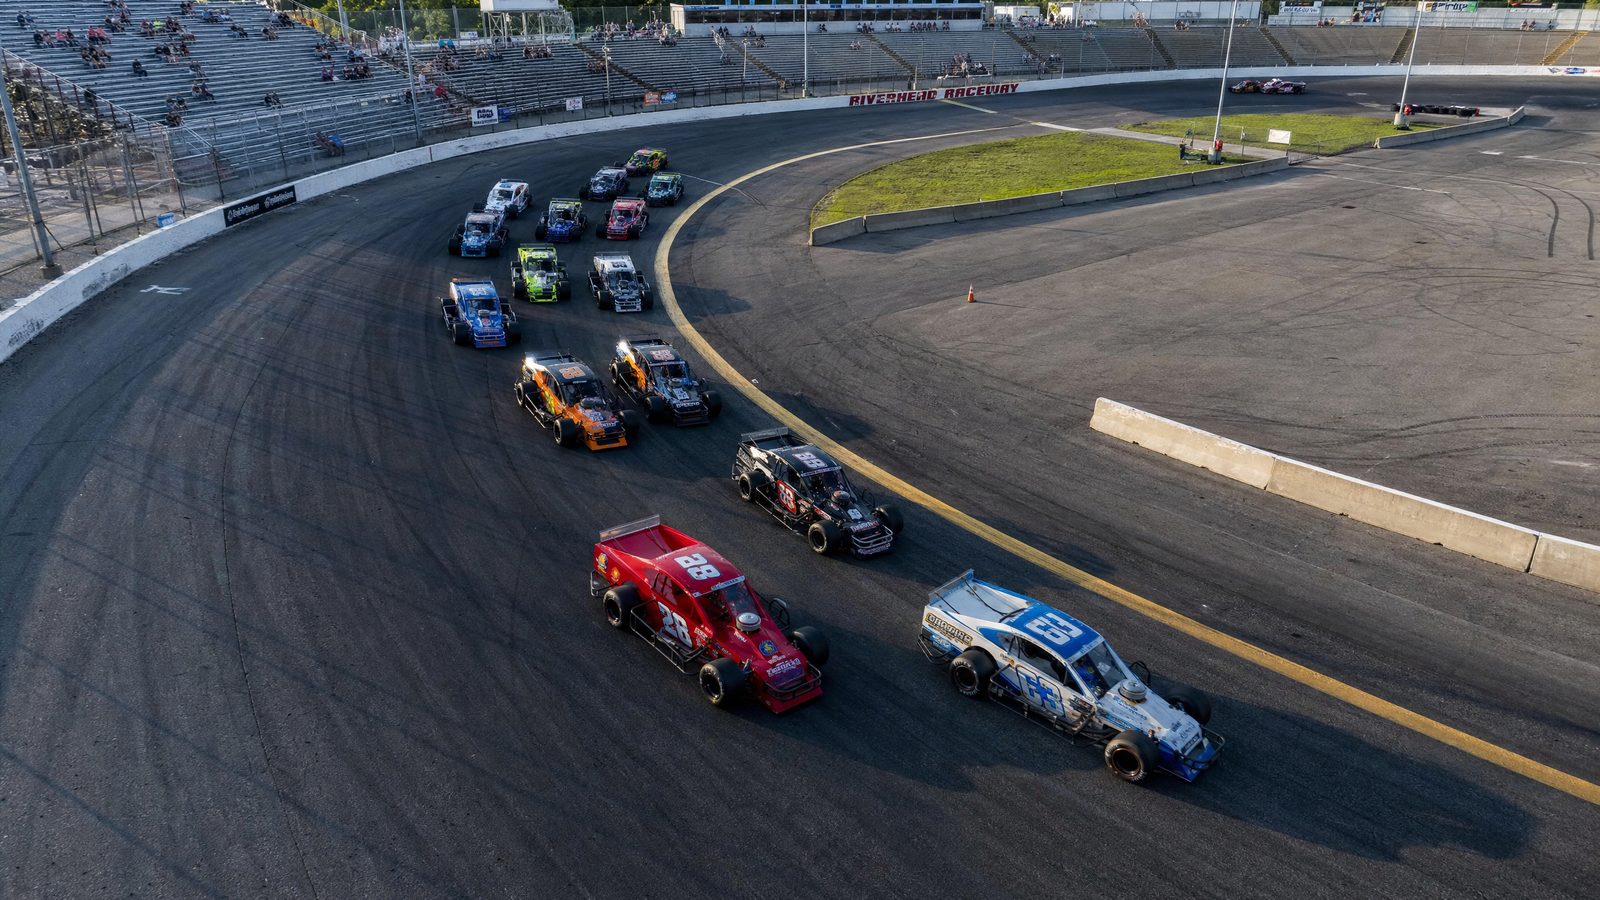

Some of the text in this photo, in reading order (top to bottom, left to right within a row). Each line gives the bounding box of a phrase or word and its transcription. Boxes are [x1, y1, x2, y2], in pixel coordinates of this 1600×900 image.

[849, 83, 1019, 106] RIVERHEAD RACEWAY
[674, 552, 721, 581] 28
[657, 601, 693, 648] 28
[1025, 612, 1083, 645] 63
[1016, 665, 1065, 718] 63
